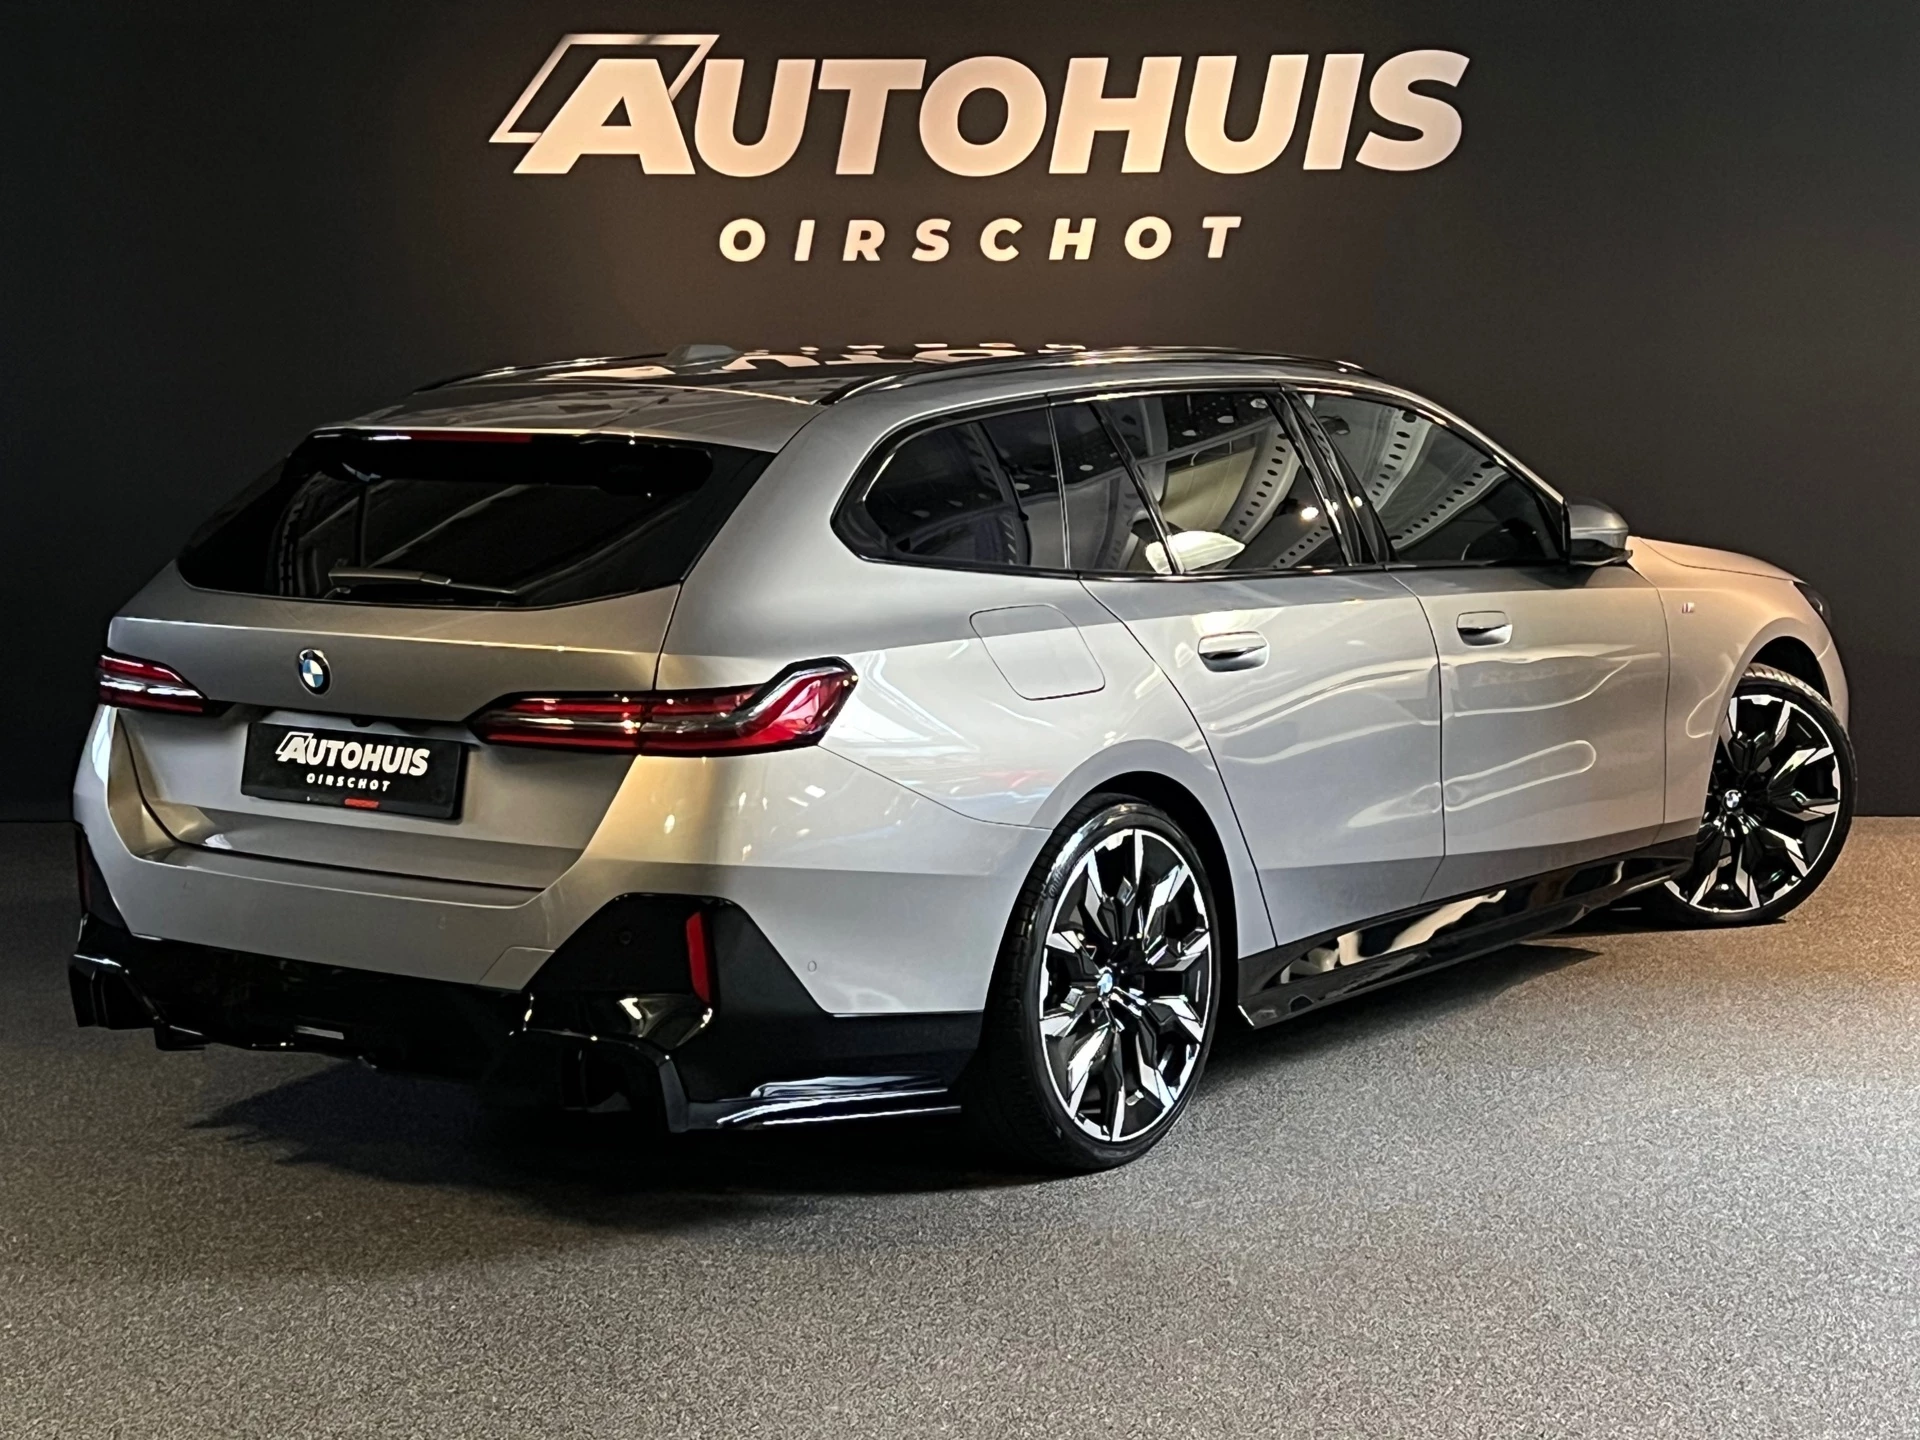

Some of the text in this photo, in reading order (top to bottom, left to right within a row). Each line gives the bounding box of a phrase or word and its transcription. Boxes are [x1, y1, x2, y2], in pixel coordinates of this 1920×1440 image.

[513, 49, 1470, 177] AUTOHUIS
[718, 216, 1241, 262] OIRSCHOT
[277, 735, 430, 776] AUTOHUIS
[306, 773, 391, 791] OIRSCHOT
